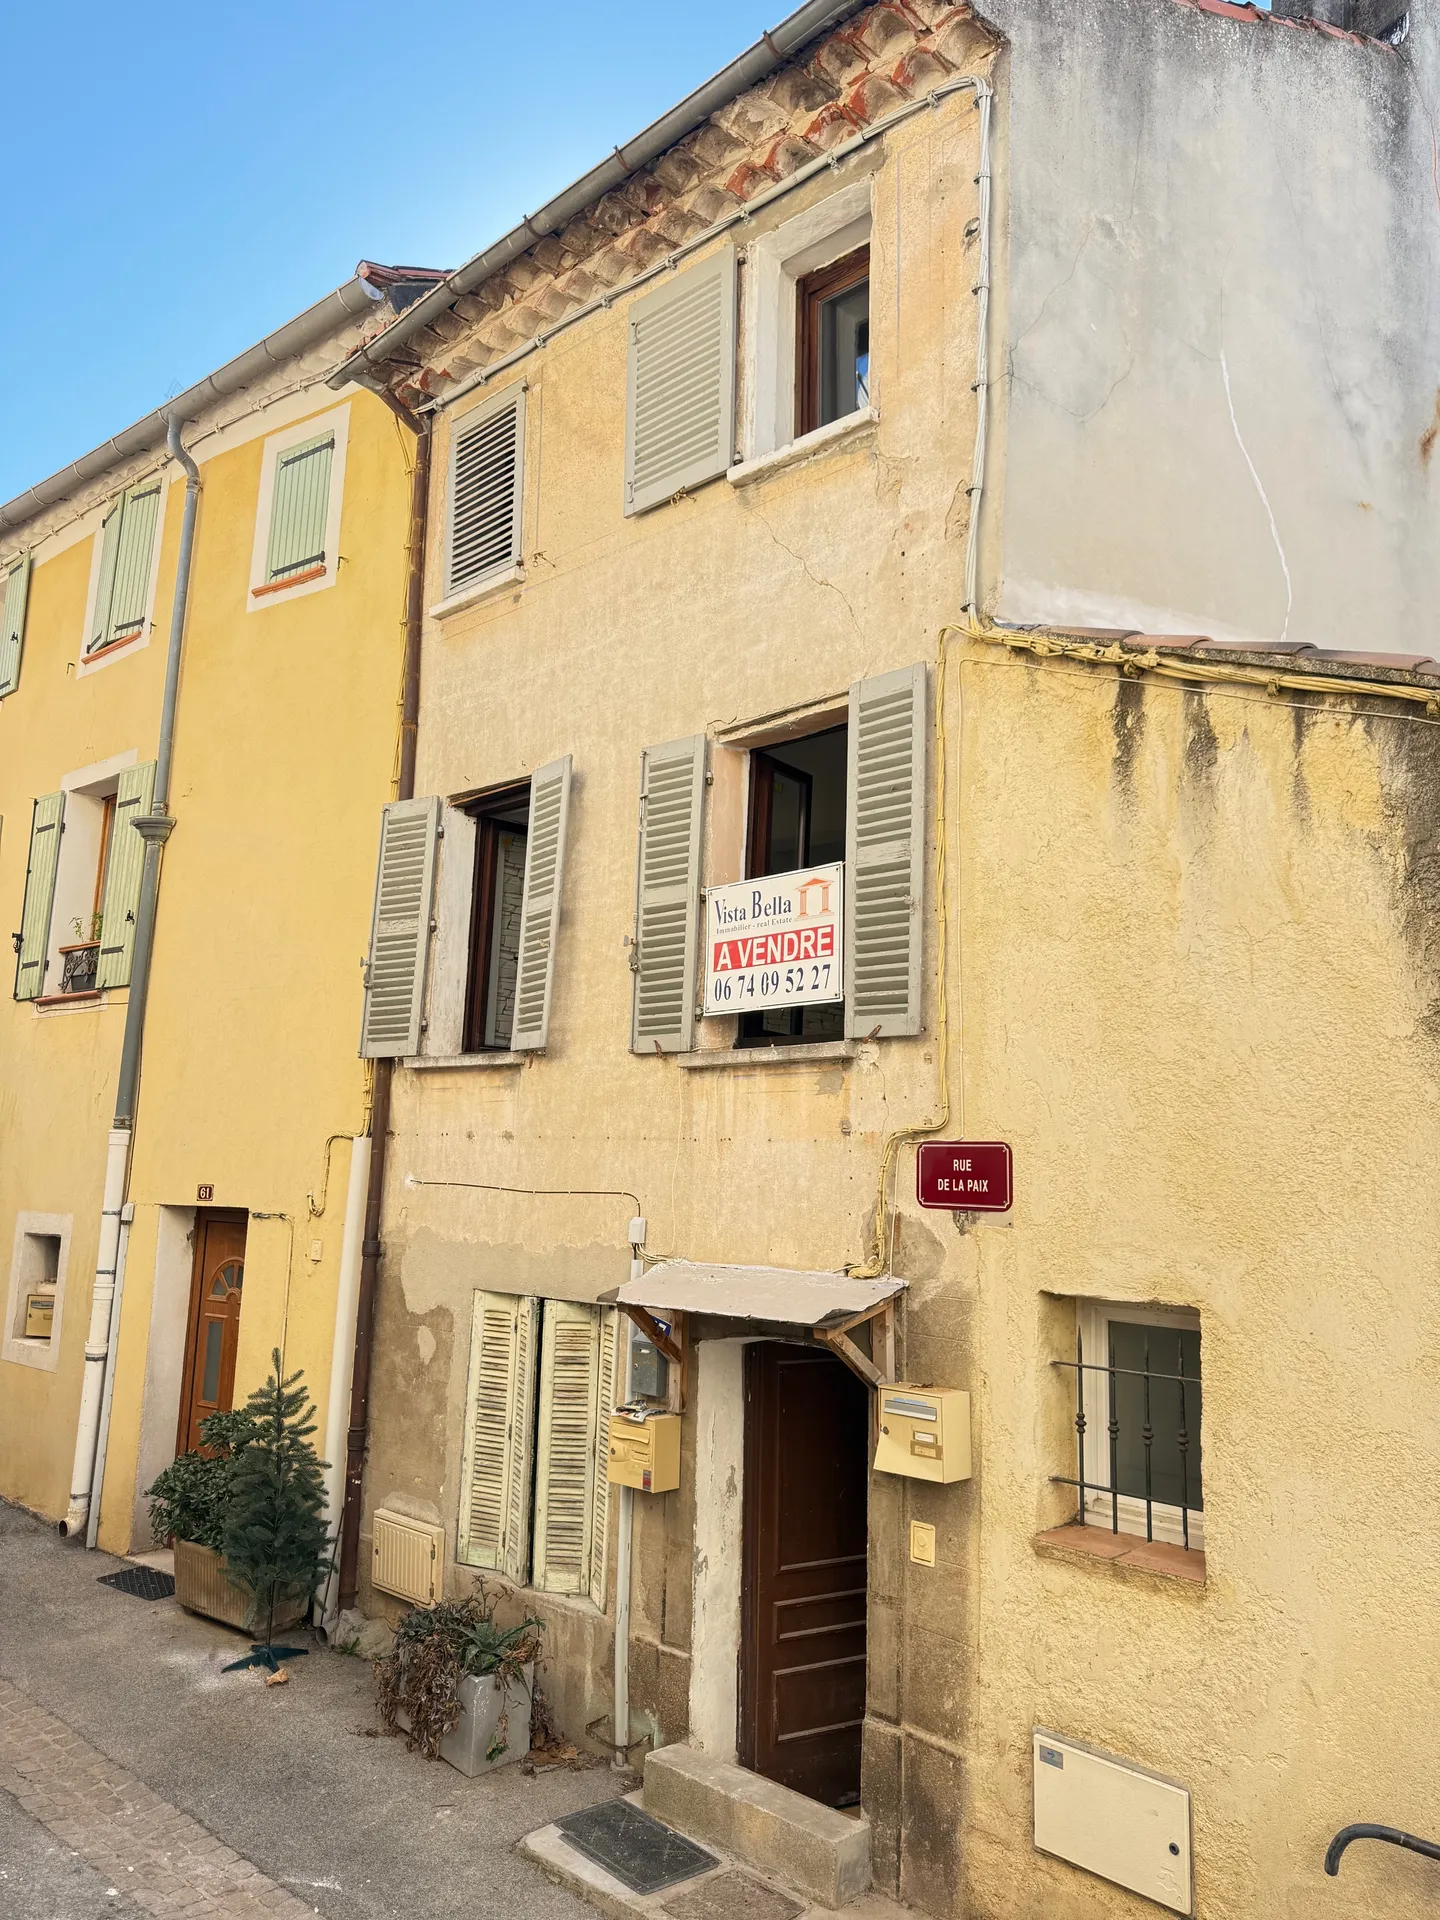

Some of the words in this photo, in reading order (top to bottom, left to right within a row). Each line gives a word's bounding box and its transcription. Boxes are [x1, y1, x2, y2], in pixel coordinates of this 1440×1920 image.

[715, 899, 746, 925] Vista
[752, 890, 792, 919] Bella
[716, 924, 751, 935] Immobilier
[757, 919, 770, 928] real
[772, 917, 792, 926] Estate
[716, 943, 732, 971] A
[737, 927, 832, 967] VENDRE
[715, 977, 732, 1001] 06
[738, 974, 755, 999] 74
[761, 970, 780, 996] 09
[786, 967, 804, 993] 52
[811, 964, 831, 990] 27
[953, 1159, 972, 1171] RUE
[200, 1187, 210, 1198] 61
[938, 1179, 950, 1191] DE
[952, 1179, 964, 1191] LA
[967, 1180, 988, 1192] PAIX
